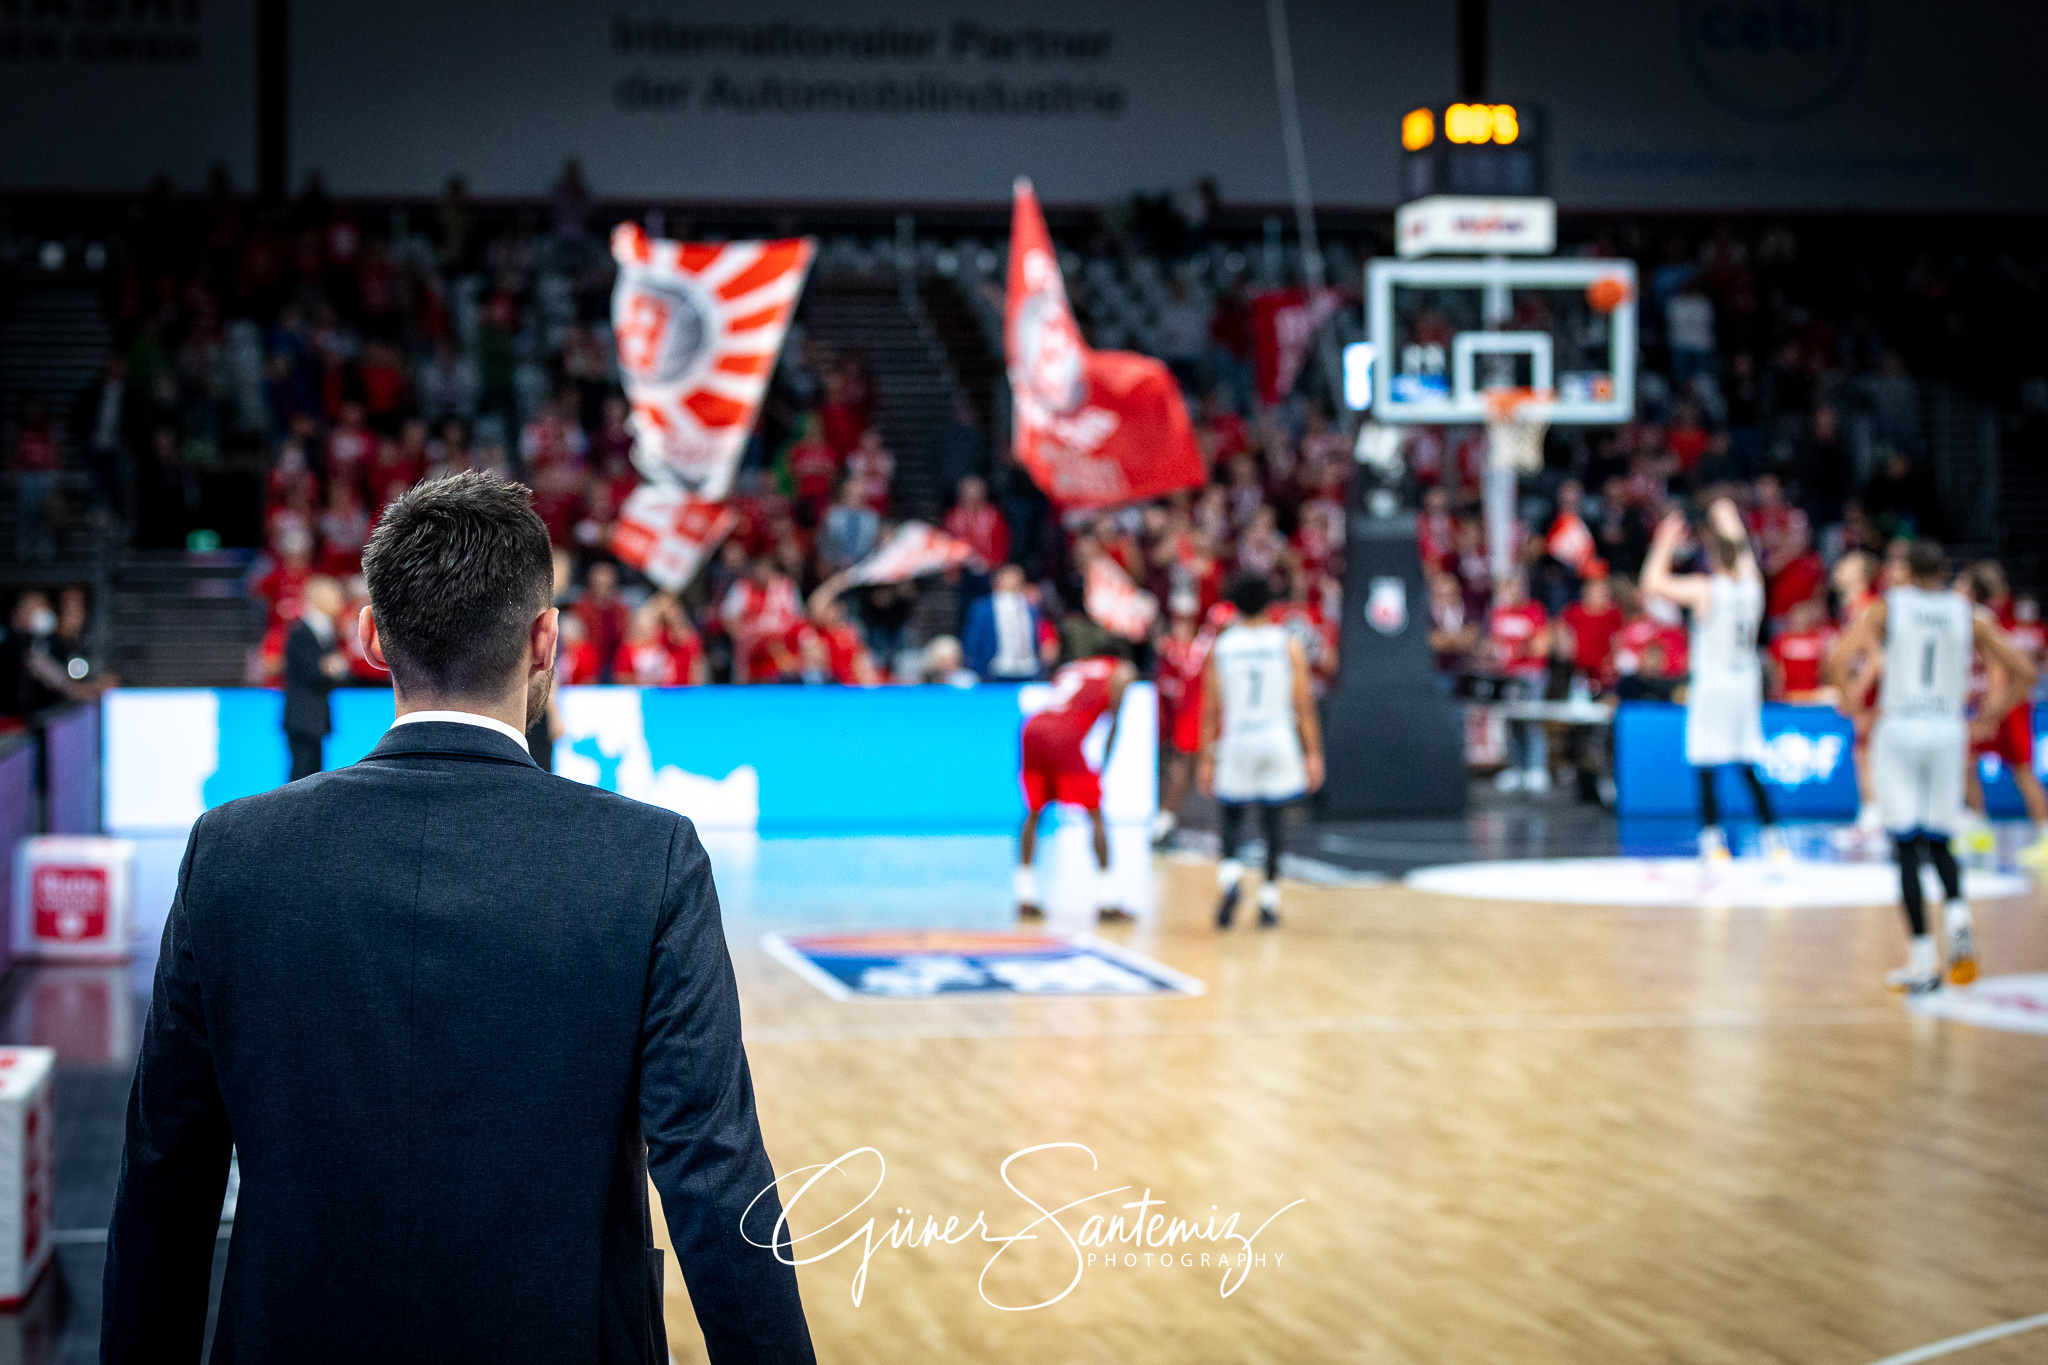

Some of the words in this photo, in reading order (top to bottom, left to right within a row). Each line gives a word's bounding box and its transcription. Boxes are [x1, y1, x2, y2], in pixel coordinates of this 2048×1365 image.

[611, 15, 938, 57] Internationaler
[949, 19, 1111, 60] Partner
[613, 71, 690, 112] der
[700, 72, 1127, 117] Automobilindustrie
